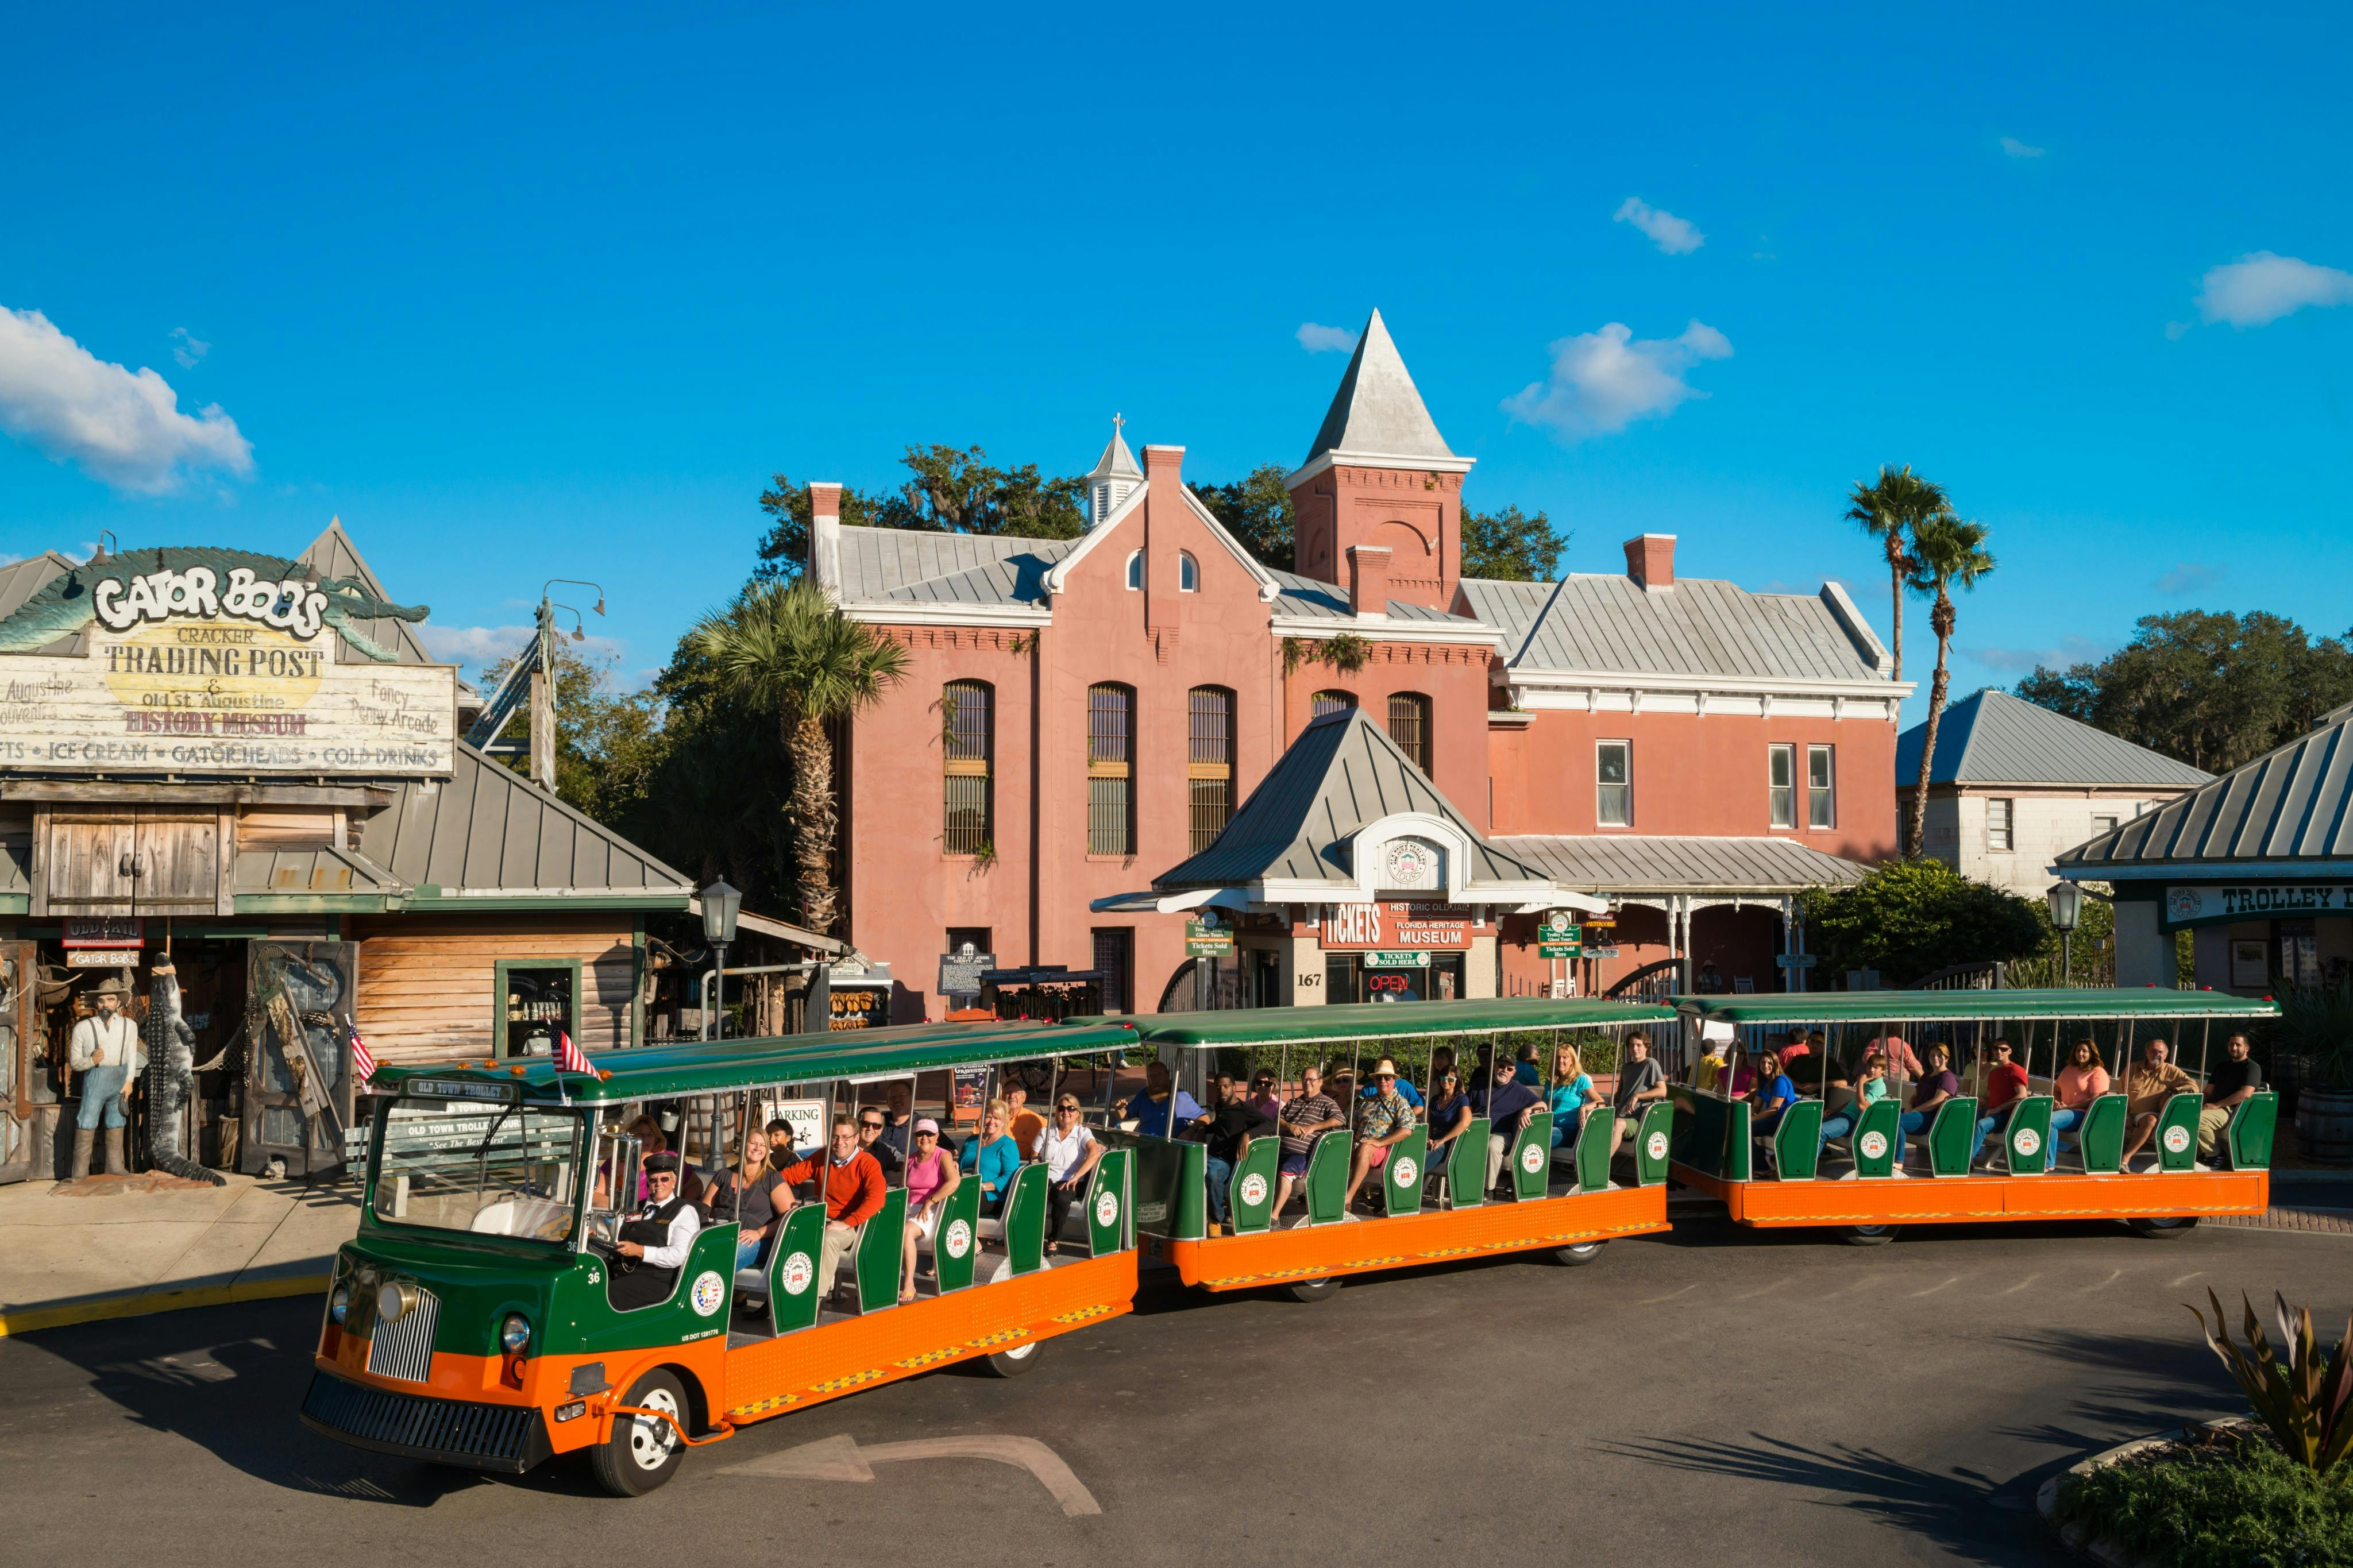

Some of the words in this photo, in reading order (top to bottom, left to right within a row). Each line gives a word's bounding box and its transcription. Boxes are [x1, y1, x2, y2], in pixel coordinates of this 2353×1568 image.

[93, 565, 219, 631] GATOR
[221, 566, 329, 639] BOB'S
[178, 627, 256, 644] CRACKER
[104, 646, 240, 675] TRADING
[248, 648, 325, 678] POST
[6, 678, 73, 702] Augustine
[207, 678, 221, 696] &
[365, 678, 410, 711] Fancy
[142, 693, 169, 707] Old
[200, 693, 286, 710] Augustine
[125, 710, 217, 734] HISTORY
[221, 712, 306, 736] MUSEUM
[346, 697, 388, 730] Penny
[392, 708, 438, 735] Arcade
[48, 741, 77, 760] ICE
[82, 743, 148, 761] CREAM
[172, 746, 242, 763] GATOR
[242, 747, 302, 764] HEADS
[323, 747, 371, 764] COLD
[375, 748, 438, 767] DRINKS
[1394, 844, 1408, 855] TOWN
[1409, 844, 1425, 866] TROLLEY
[1396, 870, 1421, 881] TOURS
[2222, 887, 2333, 914] TROLLEY
[70, 921, 101, 936] OLD
[102, 920, 138, 937] JAIL
[1325, 902, 1380, 944] TICKETS
[1389, 903, 1430, 912] HISTORIC
[1432, 903, 1450, 912] OLD
[1452, 903, 1469, 912] JAIL
[1398, 931, 1462, 944] MUSEUM
[75, 954, 108, 964] GATOR
[109, 953, 136, 964] BOB'S
[1298, 974, 1321, 987] 167
[1370, 975, 1409, 991] OPEN
[418, 1082, 434, 1093] OLD
[437, 1083, 461, 1094] TOWN
[464, 1084, 502, 1098] TROLLEY
[458, 1104, 484, 1113] TOWN
[770, 1109, 819, 1121] PARKING
[408, 1126, 426, 1136] OLD
[428, 1124, 454, 1134] TOWN
[466, 1138, 484, 1146] Best
[567, 1241, 577, 1252] 36
[587, 1272, 600, 1284] 36
[700, 1328, 719, 1338] 1281776
